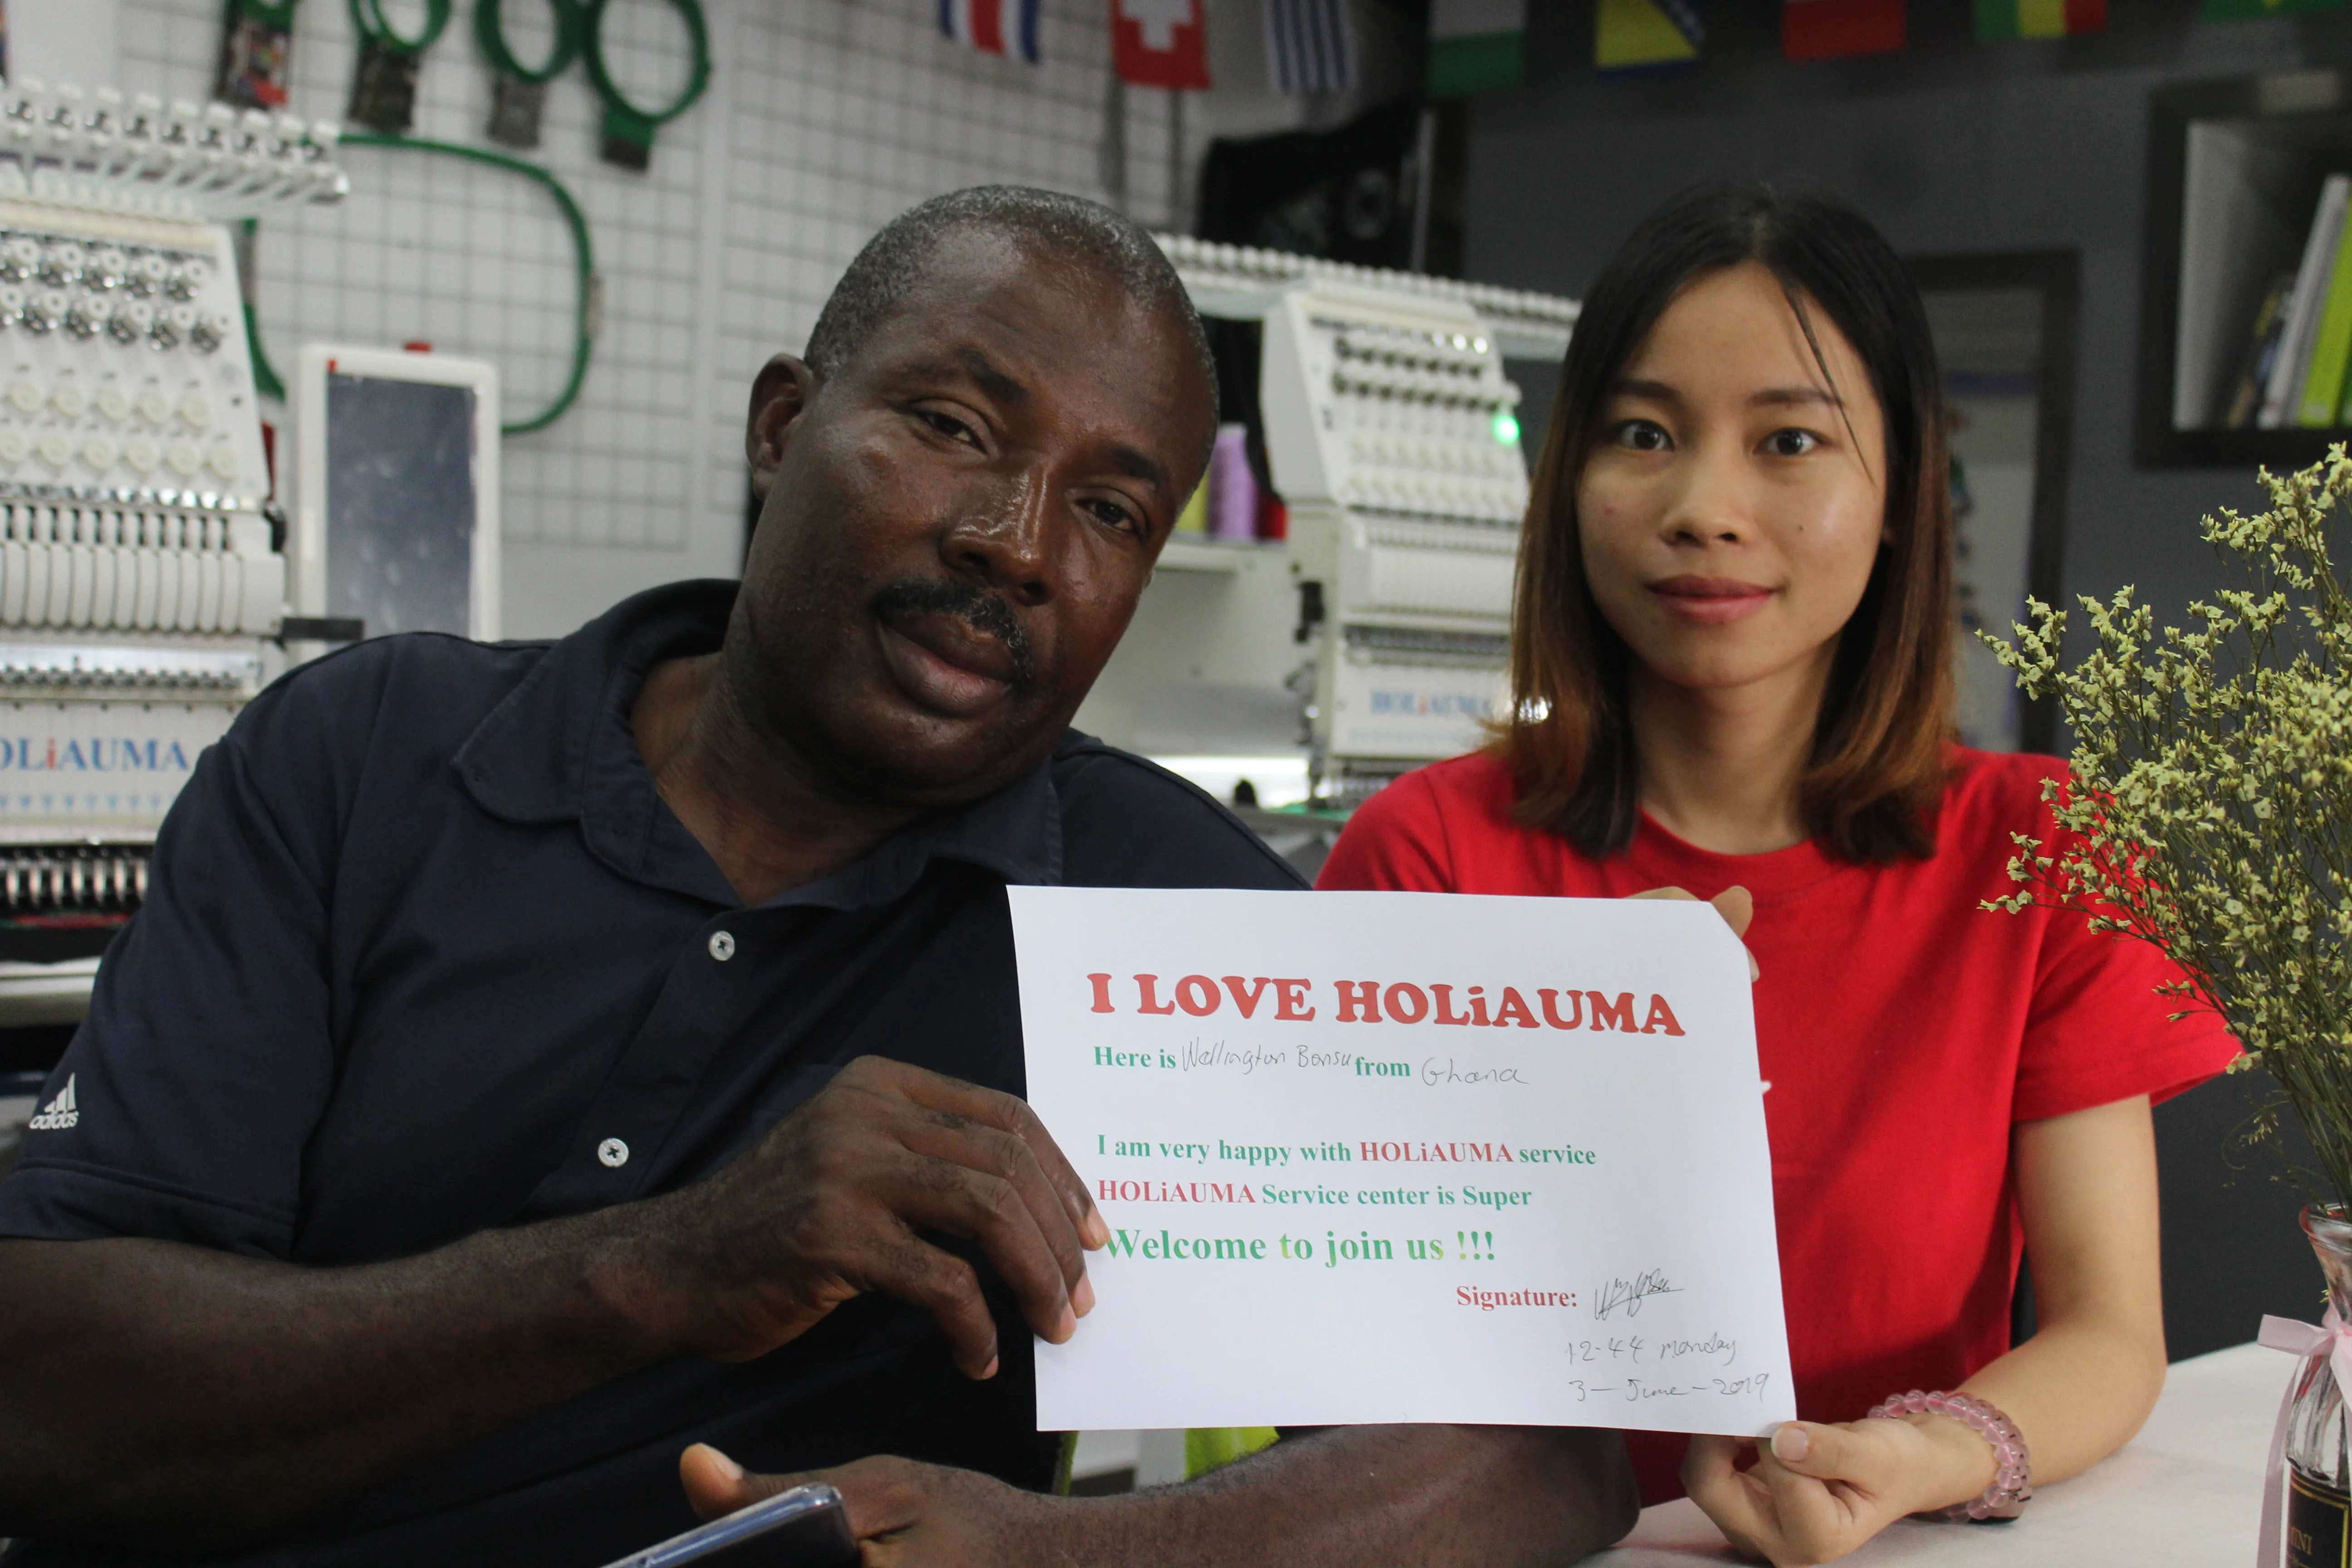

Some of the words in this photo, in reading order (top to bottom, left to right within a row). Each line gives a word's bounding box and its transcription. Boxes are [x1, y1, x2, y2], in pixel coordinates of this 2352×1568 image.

[1086, 972, 1116, 1014] I
[1132, 973, 1316, 1022] LOVE
[1333, 979, 1686, 1038] HOLiAUMA
[1093, 1046, 1152, 1068] Here
[1158, 1048, 1177, 1069] is
[1354, 1056, 1411, 1077] from
[1421, 1057, 1530, 1087] Ghana
[1097, 1134, 1106, 1156] I
[1114, 1141, 1152, 1157] am
[1159, 1142, 1211, 1165] very
[1218, 1139, 1292, 1167] happy
[1298, 1141, 1352, 1162] with
[1359, 1141, 1514, 1163] HOLiAUMA
[1519, 1144, 1597, 1166] service
[1097, 1179, 1257, 1204] HOLiAUMA
[1261, 1183, 1350, 1205] Service
[1357, 1187, 1431, 1205] center
[1436, 1185, 1456, 1205] is
[1462, 1185, 1533, 1211] Super
[1105, 1228, 1267, 1260] Welcome
[1279, 1233, 1313, 1260] to
[1324, 1230, 1394, 1269] join
[1406, 1239, 1444, 1261] us
[1456, 1230, 1495, 1261] !!!
[1456, 1285, 1578, 1312] Signature:
